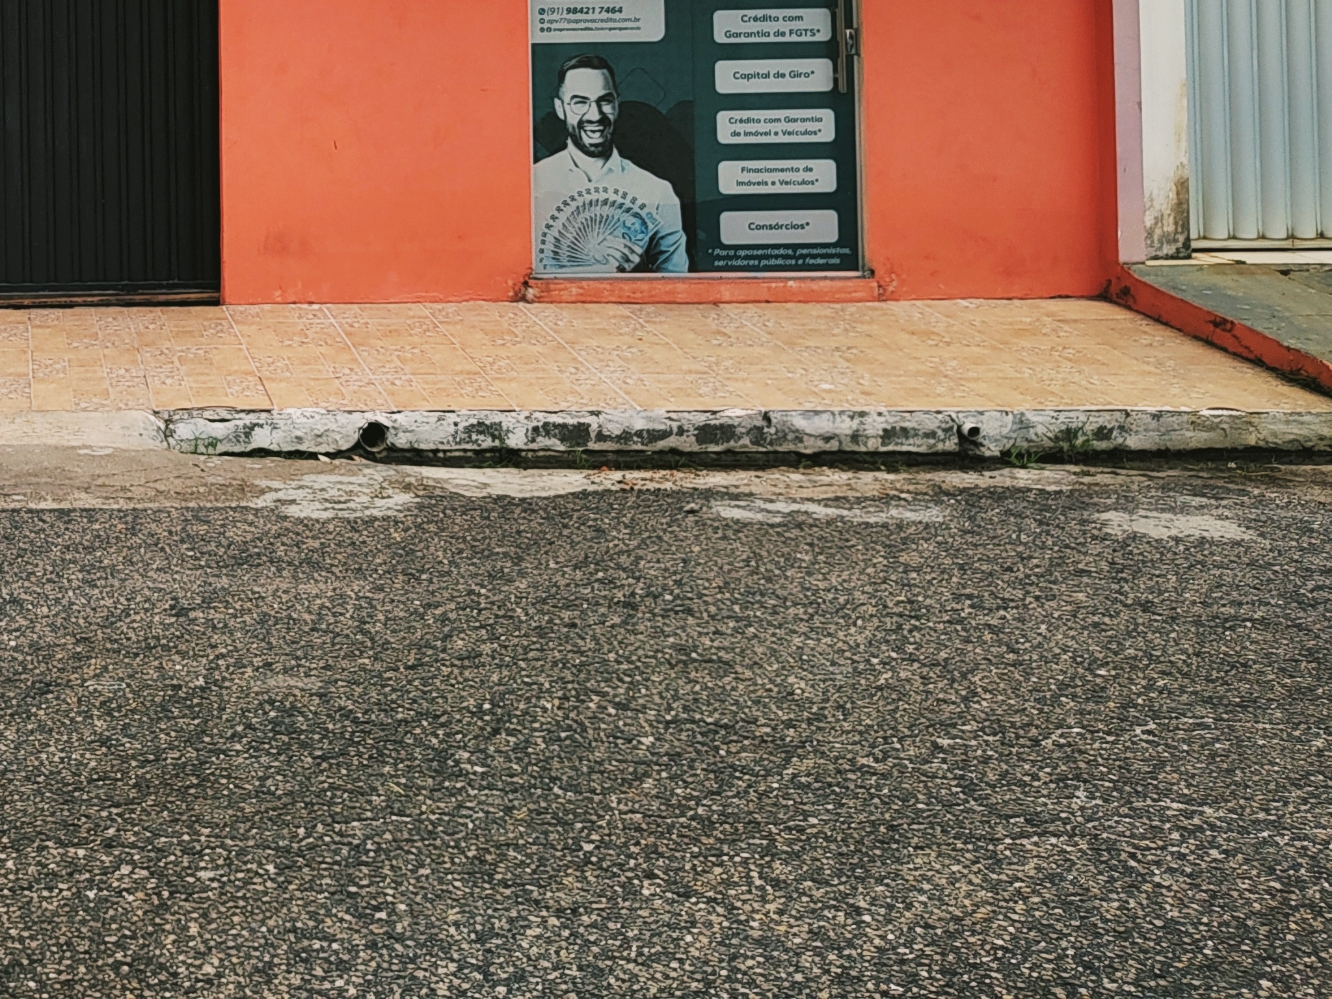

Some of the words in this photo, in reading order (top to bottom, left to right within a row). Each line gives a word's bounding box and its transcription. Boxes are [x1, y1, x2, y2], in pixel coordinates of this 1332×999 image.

[547, 7, 564, 16] (91)
[598, 6, 623, 14] 7464
[741, 14, 780, 23] Crédito
[724, 29, 771, 39] Garantia
[774, 29, 786, 37] de
[733, 71, 770, 82] Capital
[773, 71, 786, 79] de
[729, 116, 761, 125] Crédito
[784, 115, 823, 124] Garantia
[744, 129, 771, 137] Imóvel
[741, 166, 800, 175] Finaciamento
[736, 179, 769, 187] Imóveis
[714, 258, 758, 266] servidores
